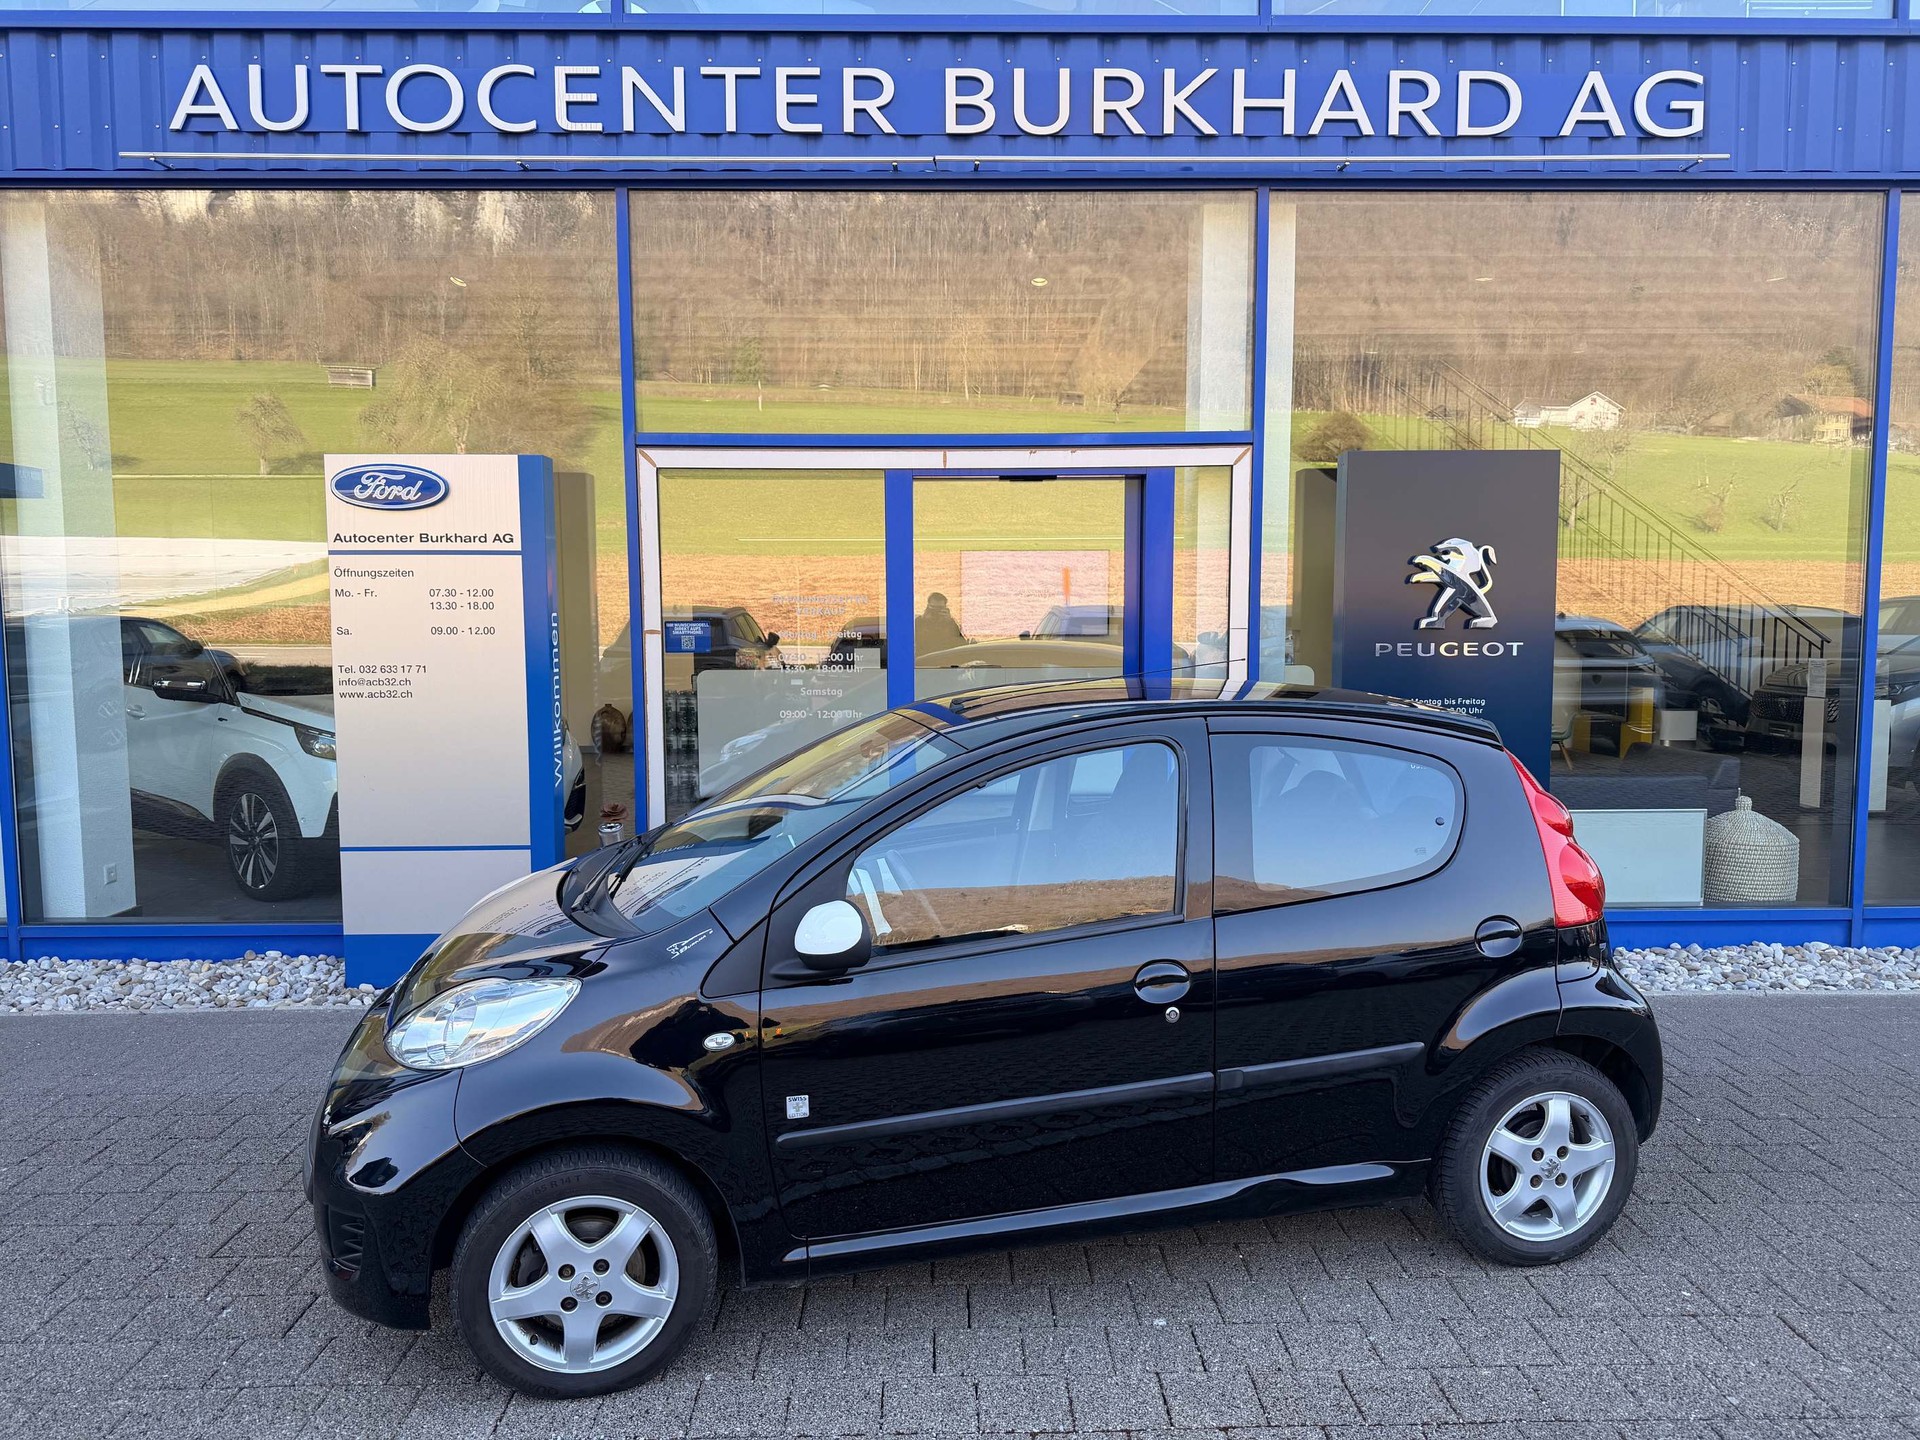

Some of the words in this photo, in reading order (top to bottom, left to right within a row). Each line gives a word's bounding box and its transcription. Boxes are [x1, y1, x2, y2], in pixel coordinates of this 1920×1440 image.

[169, 64, 897, 134] AUTOCENTER
[944, 67, 1524, 136] BURKHARD
[1559, 70, 1706, 138] AG
[354, 472, 423, 501] Ford
[333, 532, 414, 544] Autocenter
[419, 532, 487, 544] Burkhard
[492, 533, 514, 544] AG
[333, 565, 415, 579] Öffnungszeiten
[334, 588, 354, 598] Mo.
[364, 588, 378, 598] Fr.
[428, 588, 457, 598] 07.30
[466, 588, 494, 598] 12.00
[429, 601, 457, 611] 13.30
[467, 601, 495, 610] 18.00
[336, 626, 353, 636] Sa.
[430, 626, 458, 636] 09.00
[468, 626, 496, 636] 12.00
[1375, 642, 1524, 657] PEUGEOT
[846, 652, 864, 662] Uhr
[338, 664, 356, 674] Tel.
[359, 664, 377, 674] 032
[380, 664, 398, 674] 633
[401, 664, 413, 674] 17
[415, 664, 427, 674] 71
[779, 664, 806, 674] 13:30
[817, 664, 844, 673] 18:00
[846, 664, 864, 673] Uhr
[338, 677, 412, 687] info@acb32.ch
[339, 689, 413, 699] www.acb32.ch
[800, 687, 843, 698] Samstag
[551, 612, 563, 788] Willkommen
[1444, 697, 1457, 705] bis
[1457, 697, 1486, 707] Freitag
[780, 709, 807, 719] 09:00
[817, 709, 843, 719] 12:00
[845, 709, 862, 719] Uhr
[1469, 706, 1484, 714] Uhr
